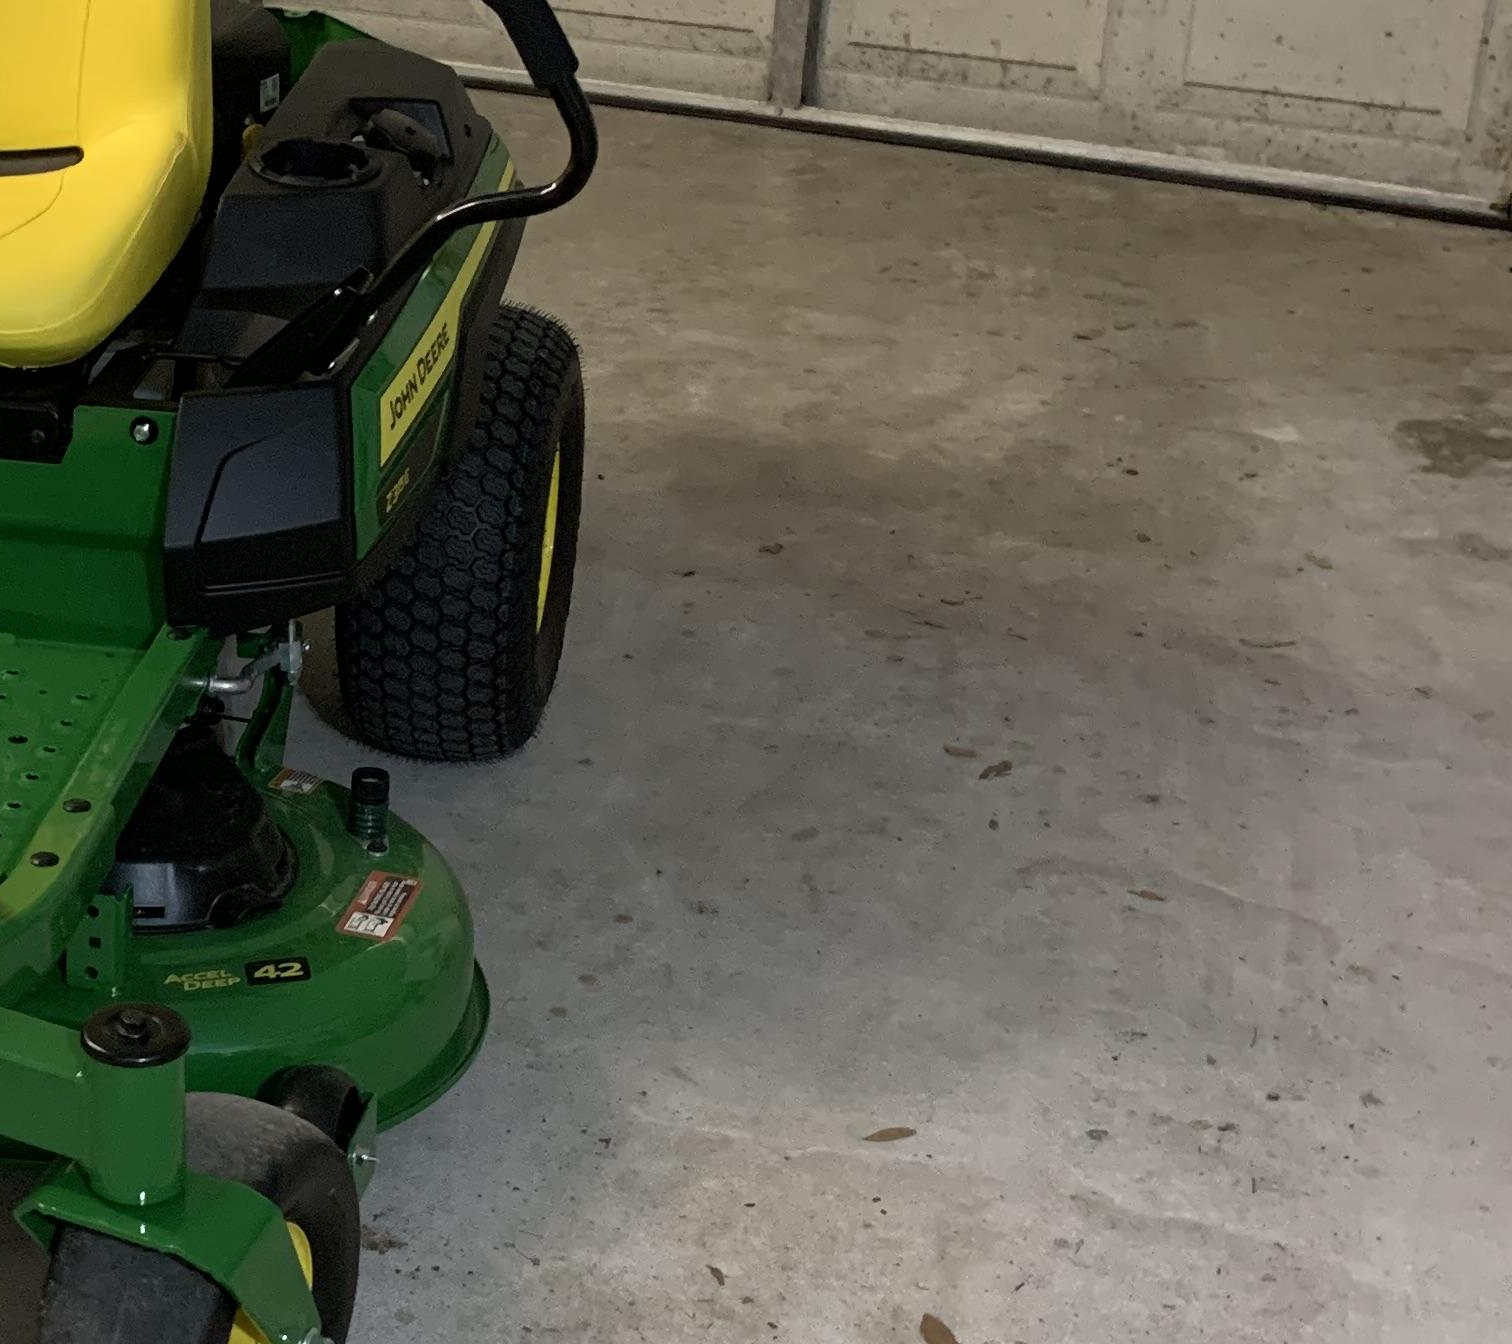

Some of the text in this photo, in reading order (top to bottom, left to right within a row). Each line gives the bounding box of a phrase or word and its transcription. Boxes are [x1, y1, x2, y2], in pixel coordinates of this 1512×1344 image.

[389, 322, 450, 431] JOHN DEERE
[163, 962, 305, 985] ACCEL 42
[183, 976, 241, 992] DEEP
